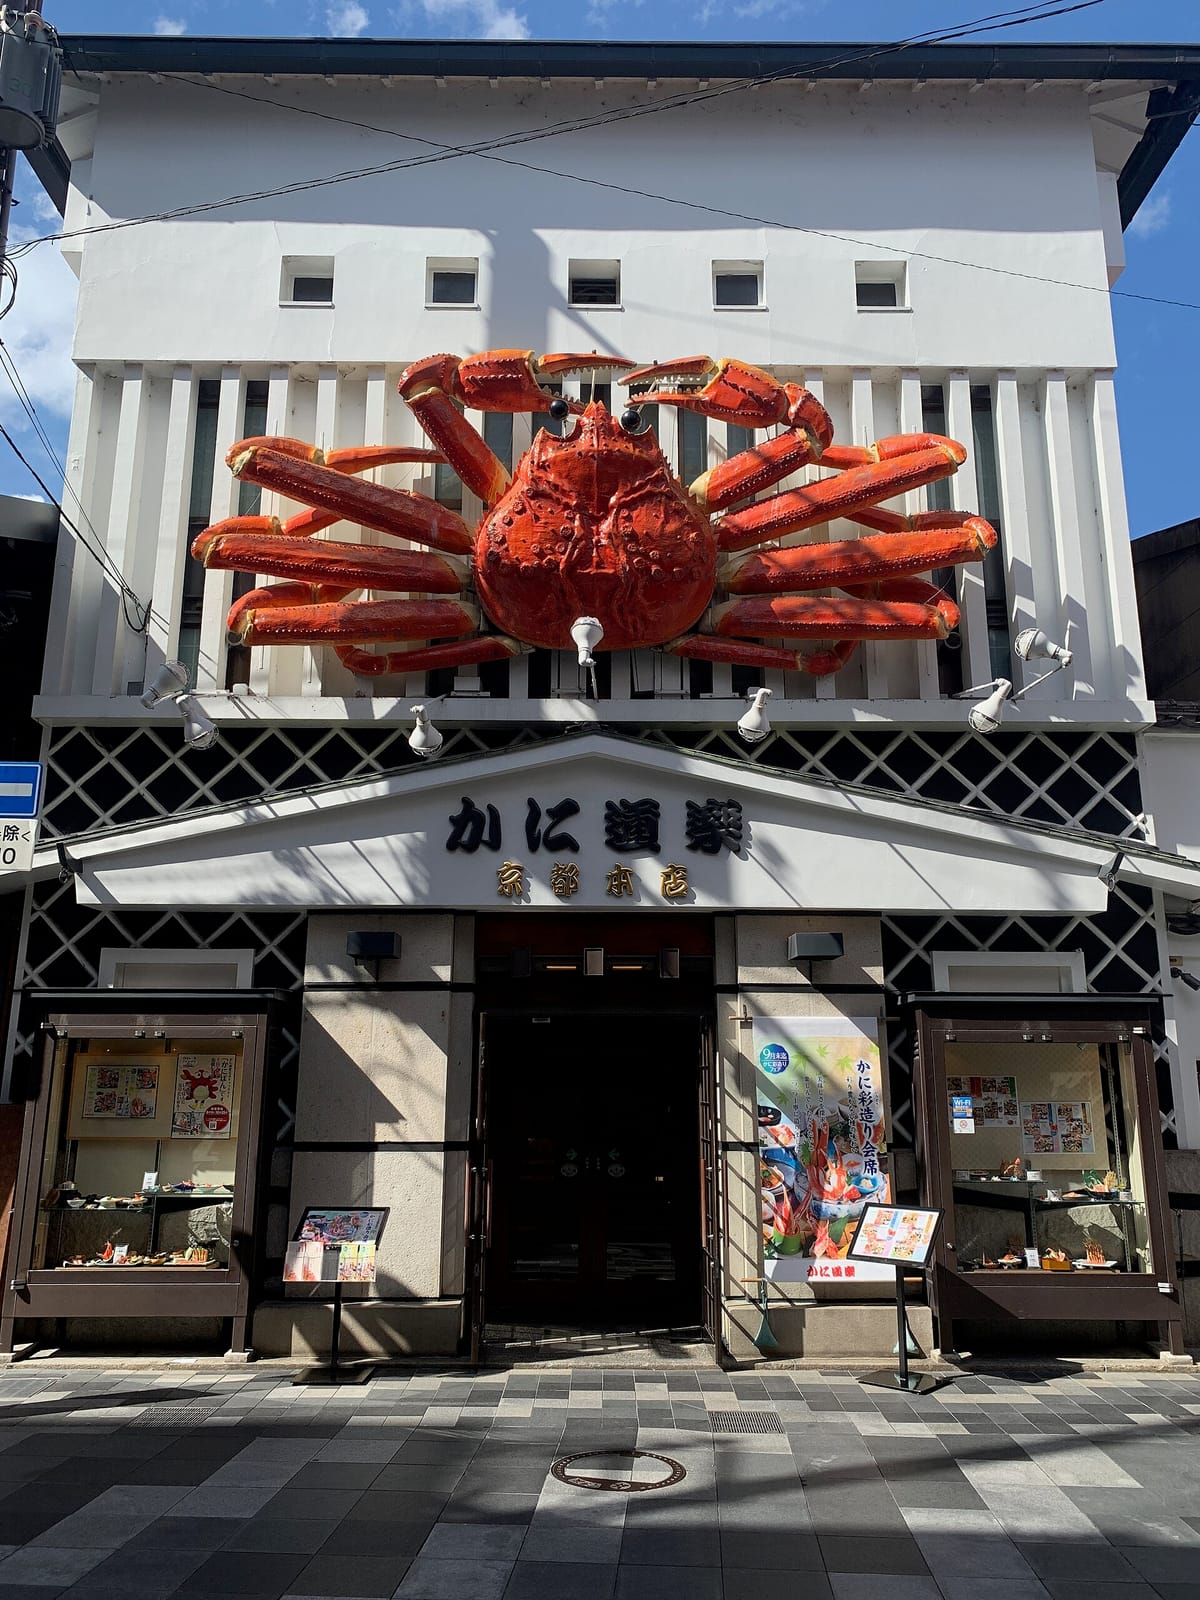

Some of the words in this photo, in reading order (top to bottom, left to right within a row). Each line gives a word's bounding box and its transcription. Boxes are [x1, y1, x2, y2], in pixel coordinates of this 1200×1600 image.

[0, 825, 31, 842] 除く
[446, 797, 743, 853] かに道楽
[0, 847, 16, 865] 0
[497, 861, 689, 897] 京都本店
[857, 1060, 878, 1176] かに彩造り会席
